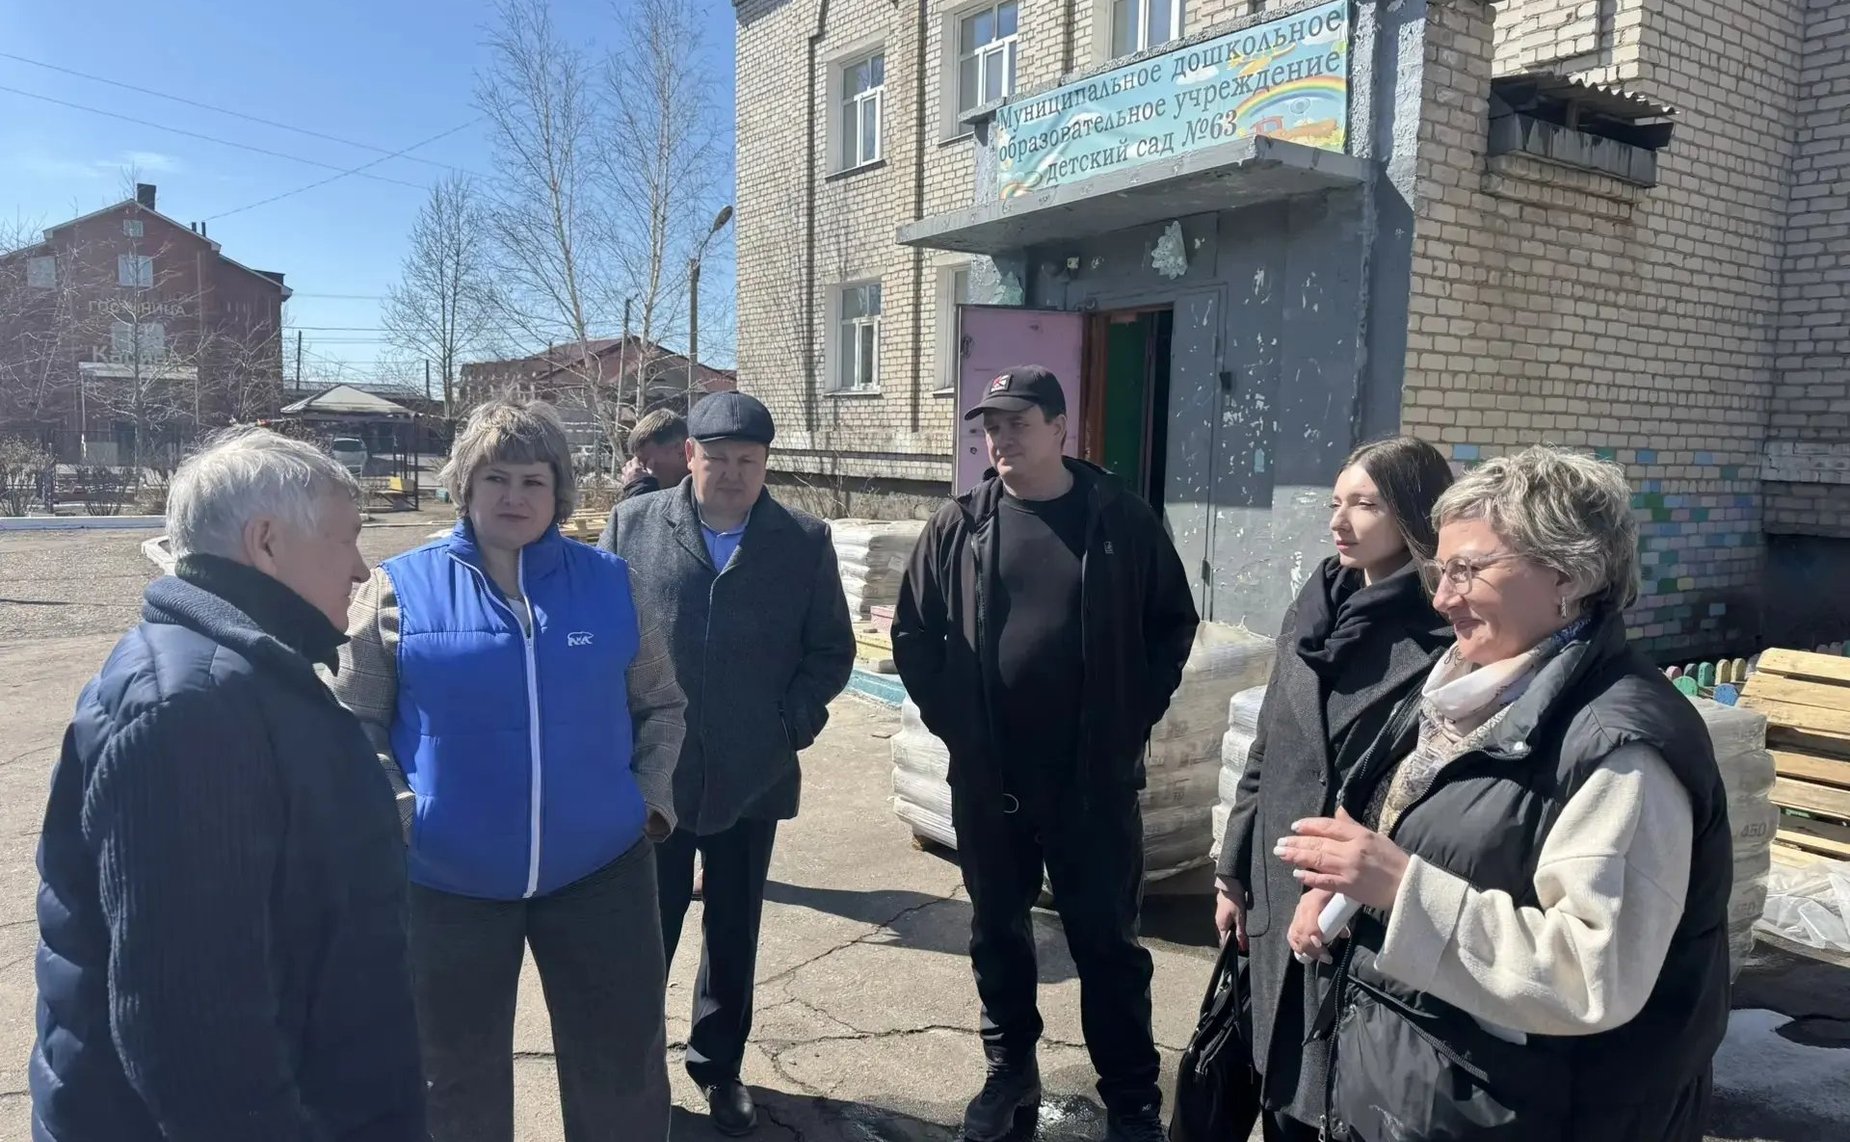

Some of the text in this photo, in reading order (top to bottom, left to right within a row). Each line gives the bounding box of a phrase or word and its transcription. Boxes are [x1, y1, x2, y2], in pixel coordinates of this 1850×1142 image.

[998, 9, 1341, 133] Муниципальное дошкольное
[999, 51, 1340, 163] образовательное учреждение
[1046, 109, 1238, 185] детский сад №63
[89, 300, 185, 315] ГОСНИЦА
